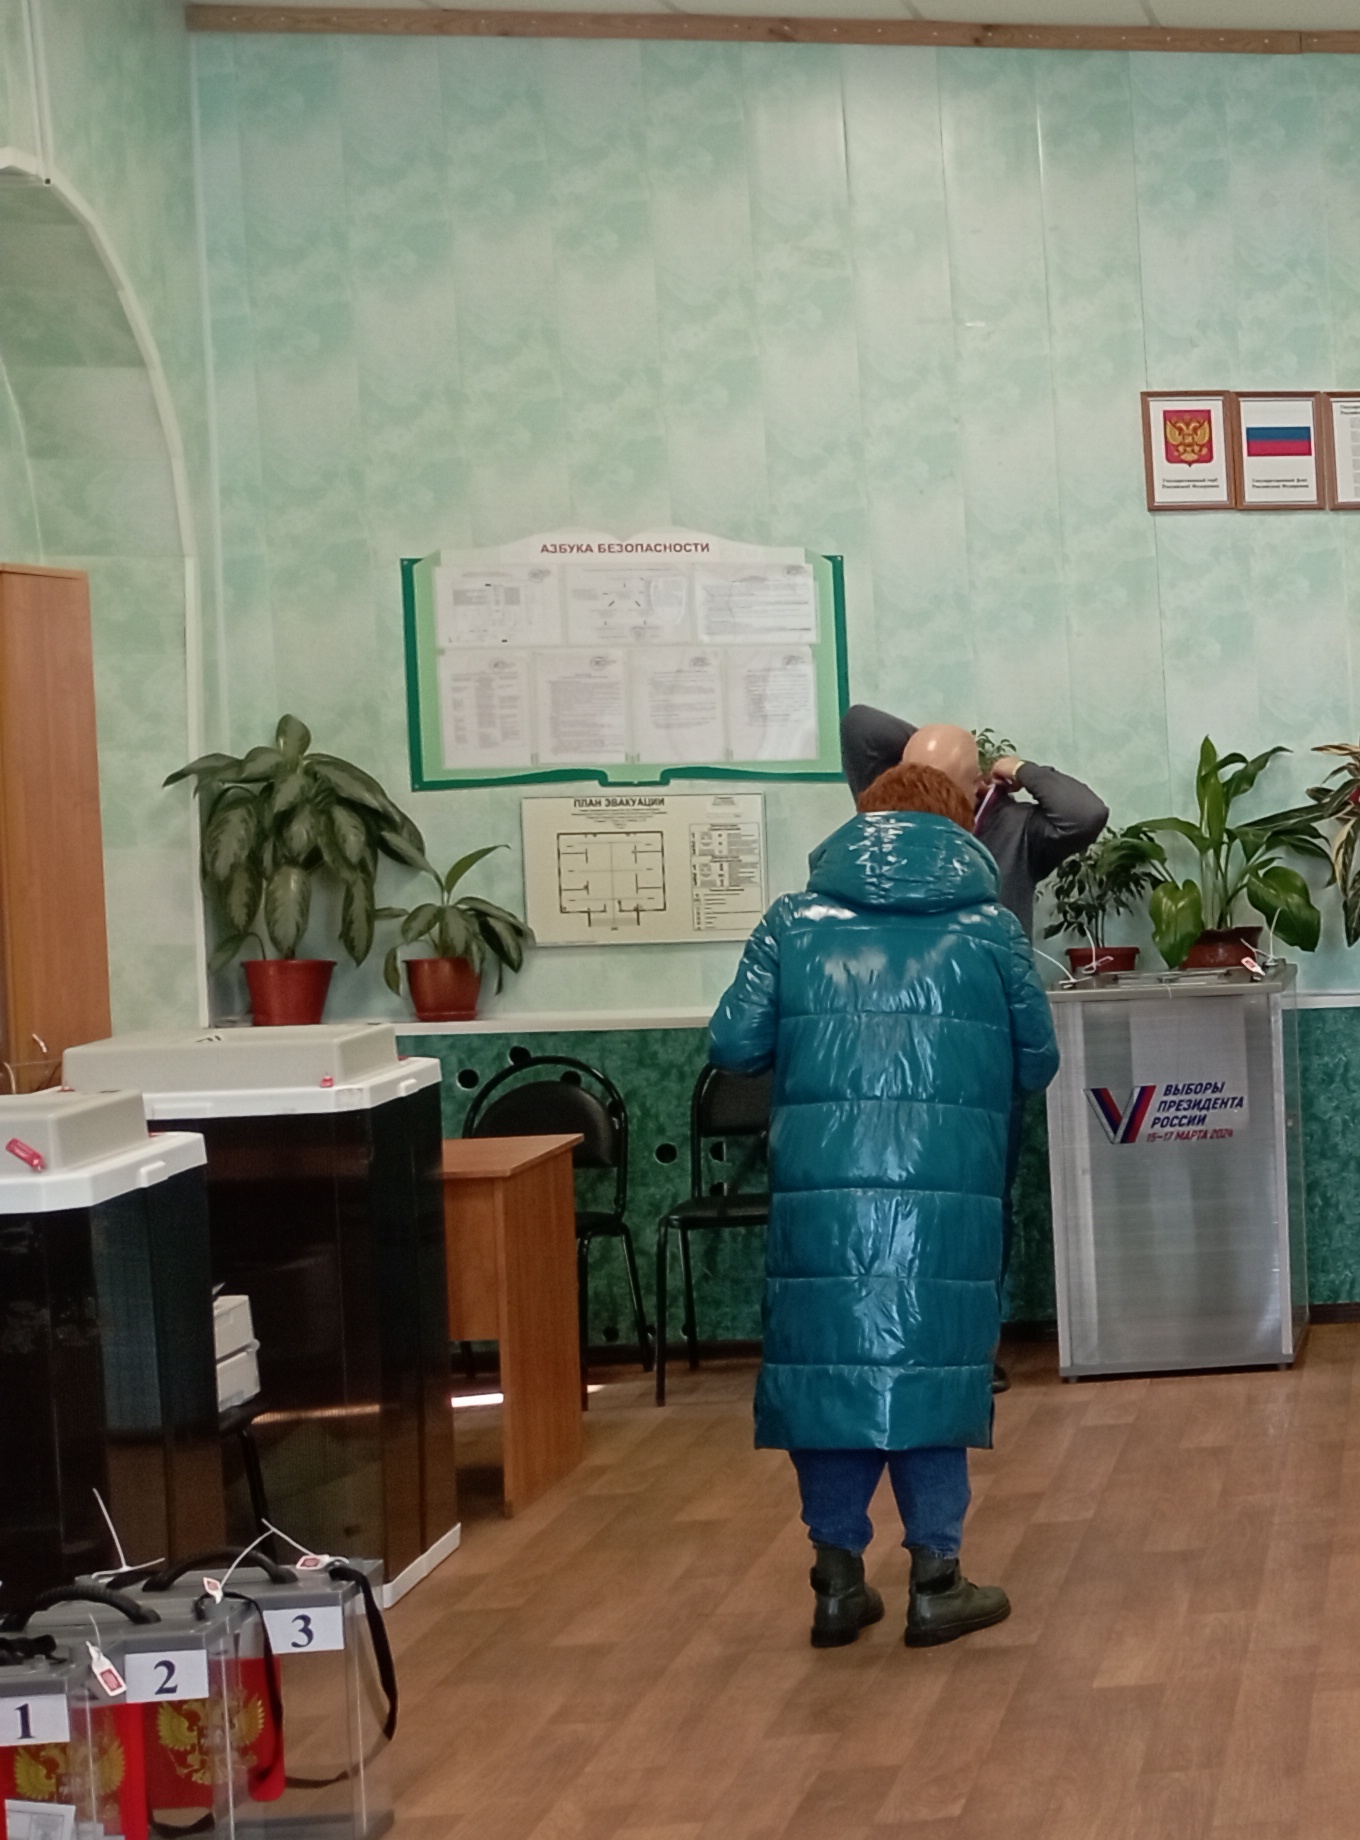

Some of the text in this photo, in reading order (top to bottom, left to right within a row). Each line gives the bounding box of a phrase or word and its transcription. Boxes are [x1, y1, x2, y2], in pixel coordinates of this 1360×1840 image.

[540, 542, 711, 554] АЗБУКА БЕЗОПАСНОСТИ
[573, 797, 665, 807] ПЛАН ЭВАКУАЦИИ
[1163, 1081, 1226, 1097] ВЫБОРЫ
[1157, 1096, 1244, 1113] ПРЕЗИДЕНТА
[1151, 1114, 1208, 1129] РОССИИ
[1174, 1129, 1208, 1141] МАРТА
[1209, 1128, 1234, 1139] 2024
[291, 1614, 314, 1649] 3
[153, 1660, 178, 1696] 2
[14, 1703, 36, 1740] 1
